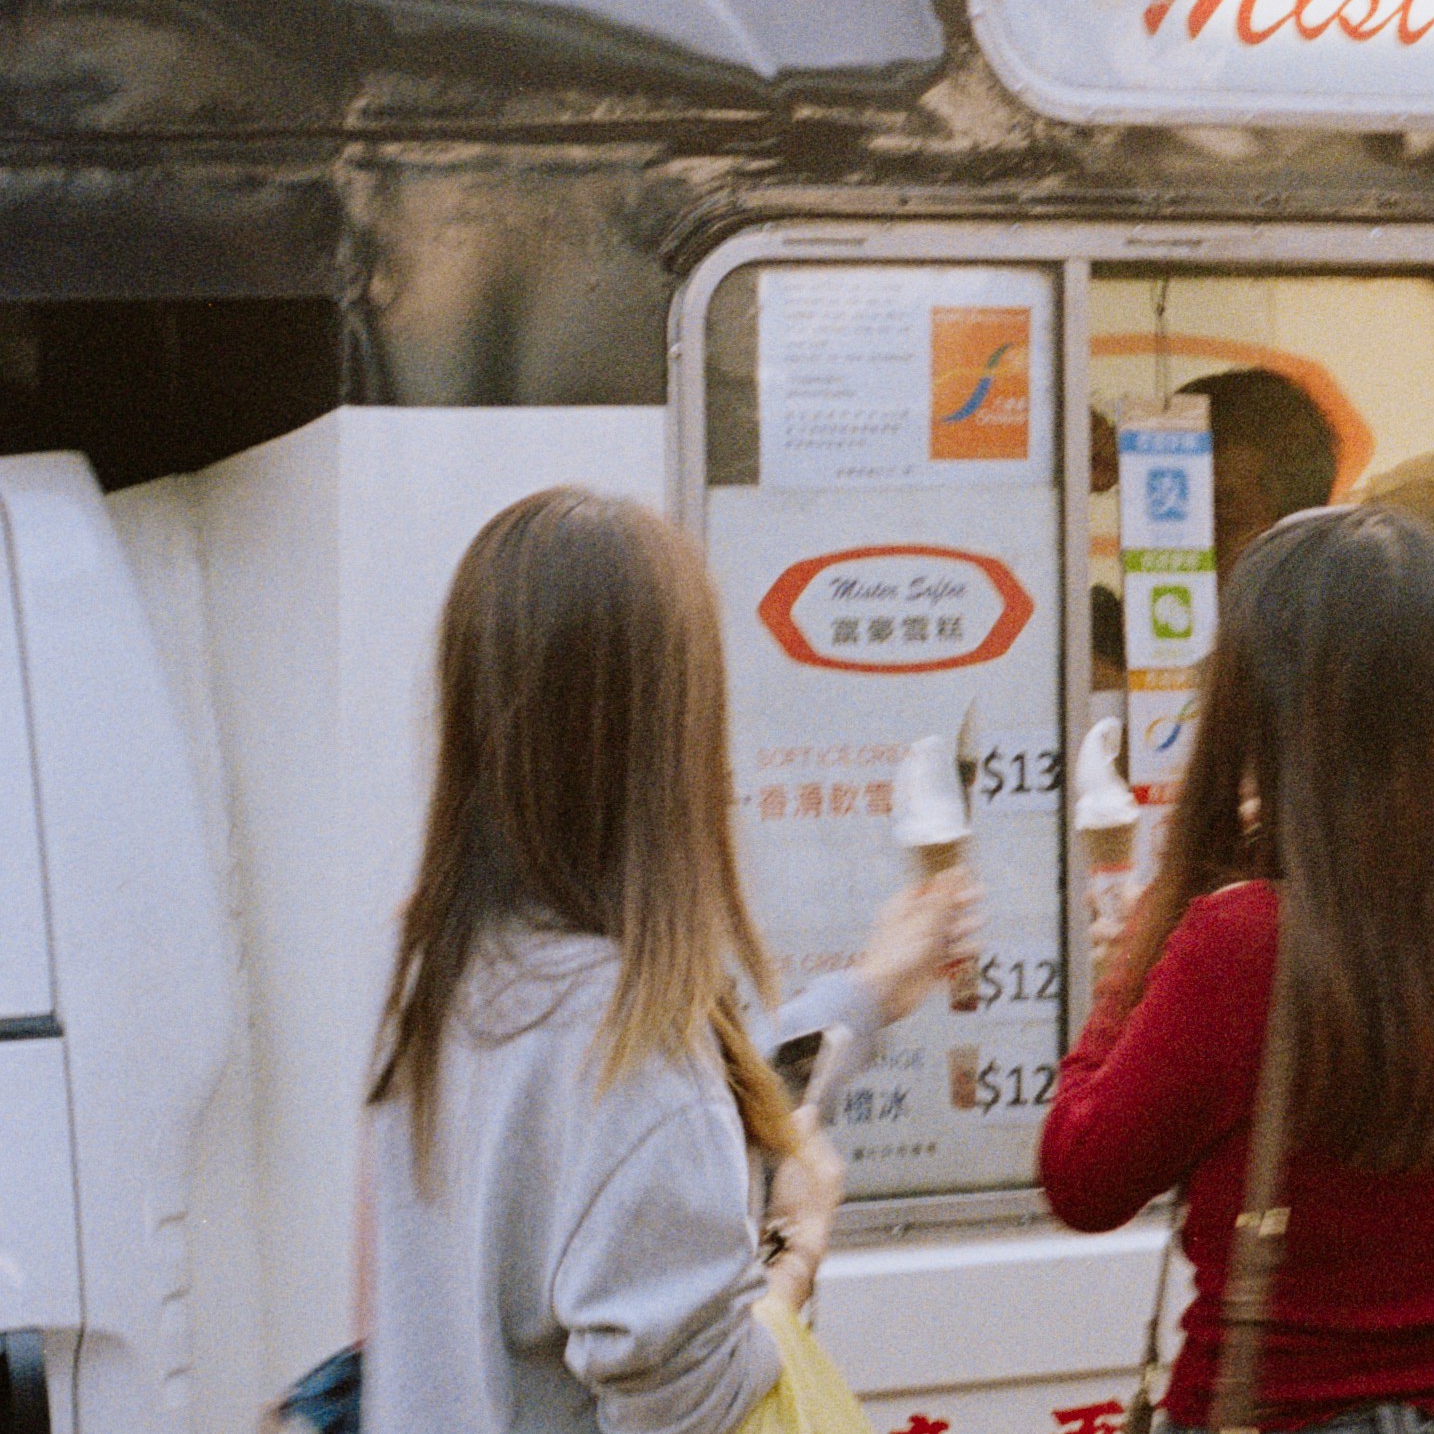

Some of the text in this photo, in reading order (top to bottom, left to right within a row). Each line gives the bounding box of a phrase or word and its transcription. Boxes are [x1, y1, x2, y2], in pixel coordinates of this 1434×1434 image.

[980, 747, 1062, 805] $13
[977, 955, 1059, 1009] $12
[976, 1058, 1057, 1116] $12
